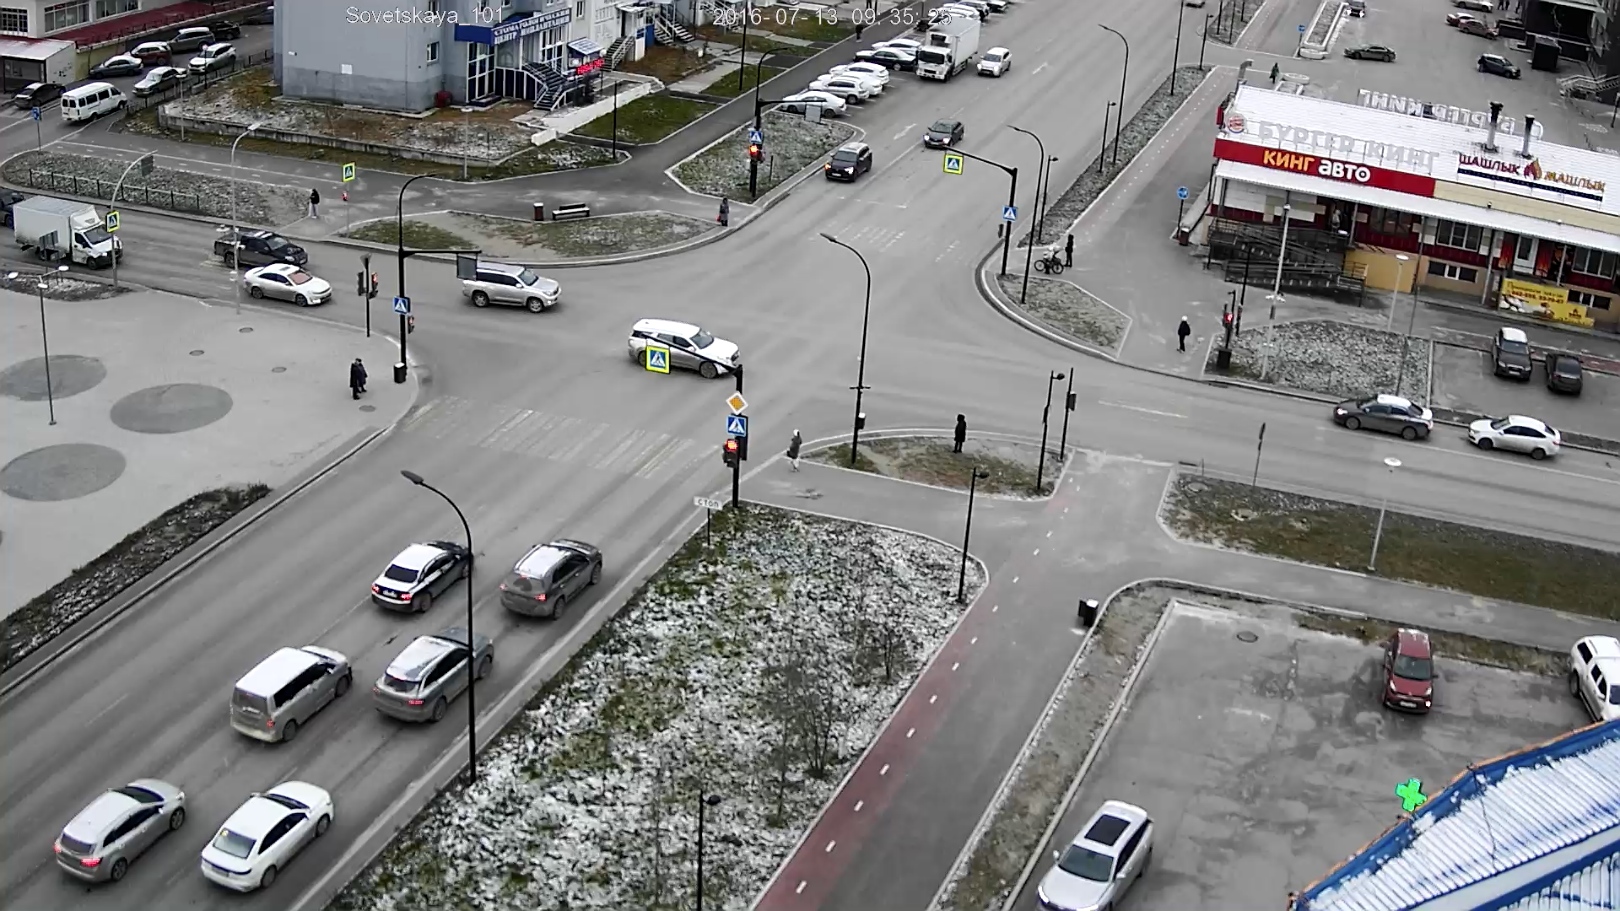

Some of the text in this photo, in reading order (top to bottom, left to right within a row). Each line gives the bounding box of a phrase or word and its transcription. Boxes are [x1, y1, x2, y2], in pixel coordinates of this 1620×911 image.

[1258, 120, 1355, 152] БУРГЕР
[1365, 139, 1440, 168] КИНГ
[1263, 149, 1316, 172] КИНГ
[1458, 152, 1520, 175] ШАШЛЫК
[1543, 170, 1606, 192] МАШЛЫК
